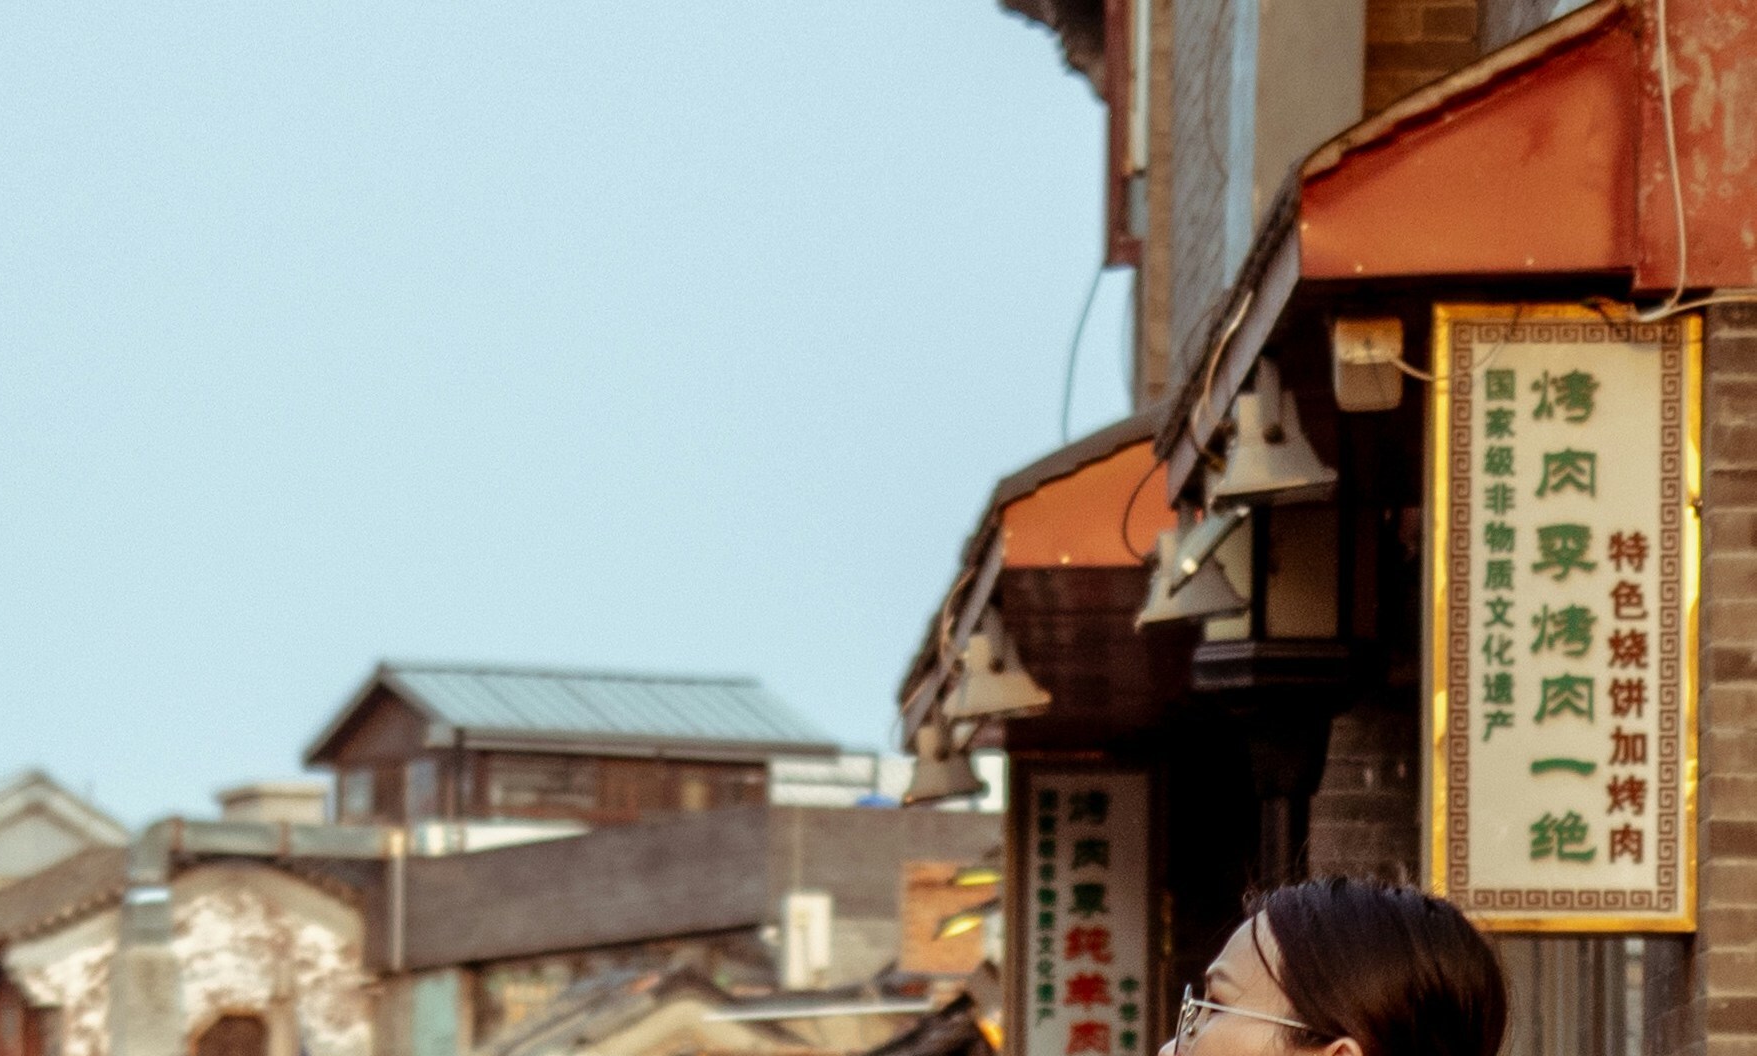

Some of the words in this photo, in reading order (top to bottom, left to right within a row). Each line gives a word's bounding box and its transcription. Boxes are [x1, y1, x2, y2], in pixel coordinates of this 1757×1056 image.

[1482, 367, 1517, 742] 国家级非物质文化遗产
[1607, 530, 1649, 866] 特色烧饼加烤肉
